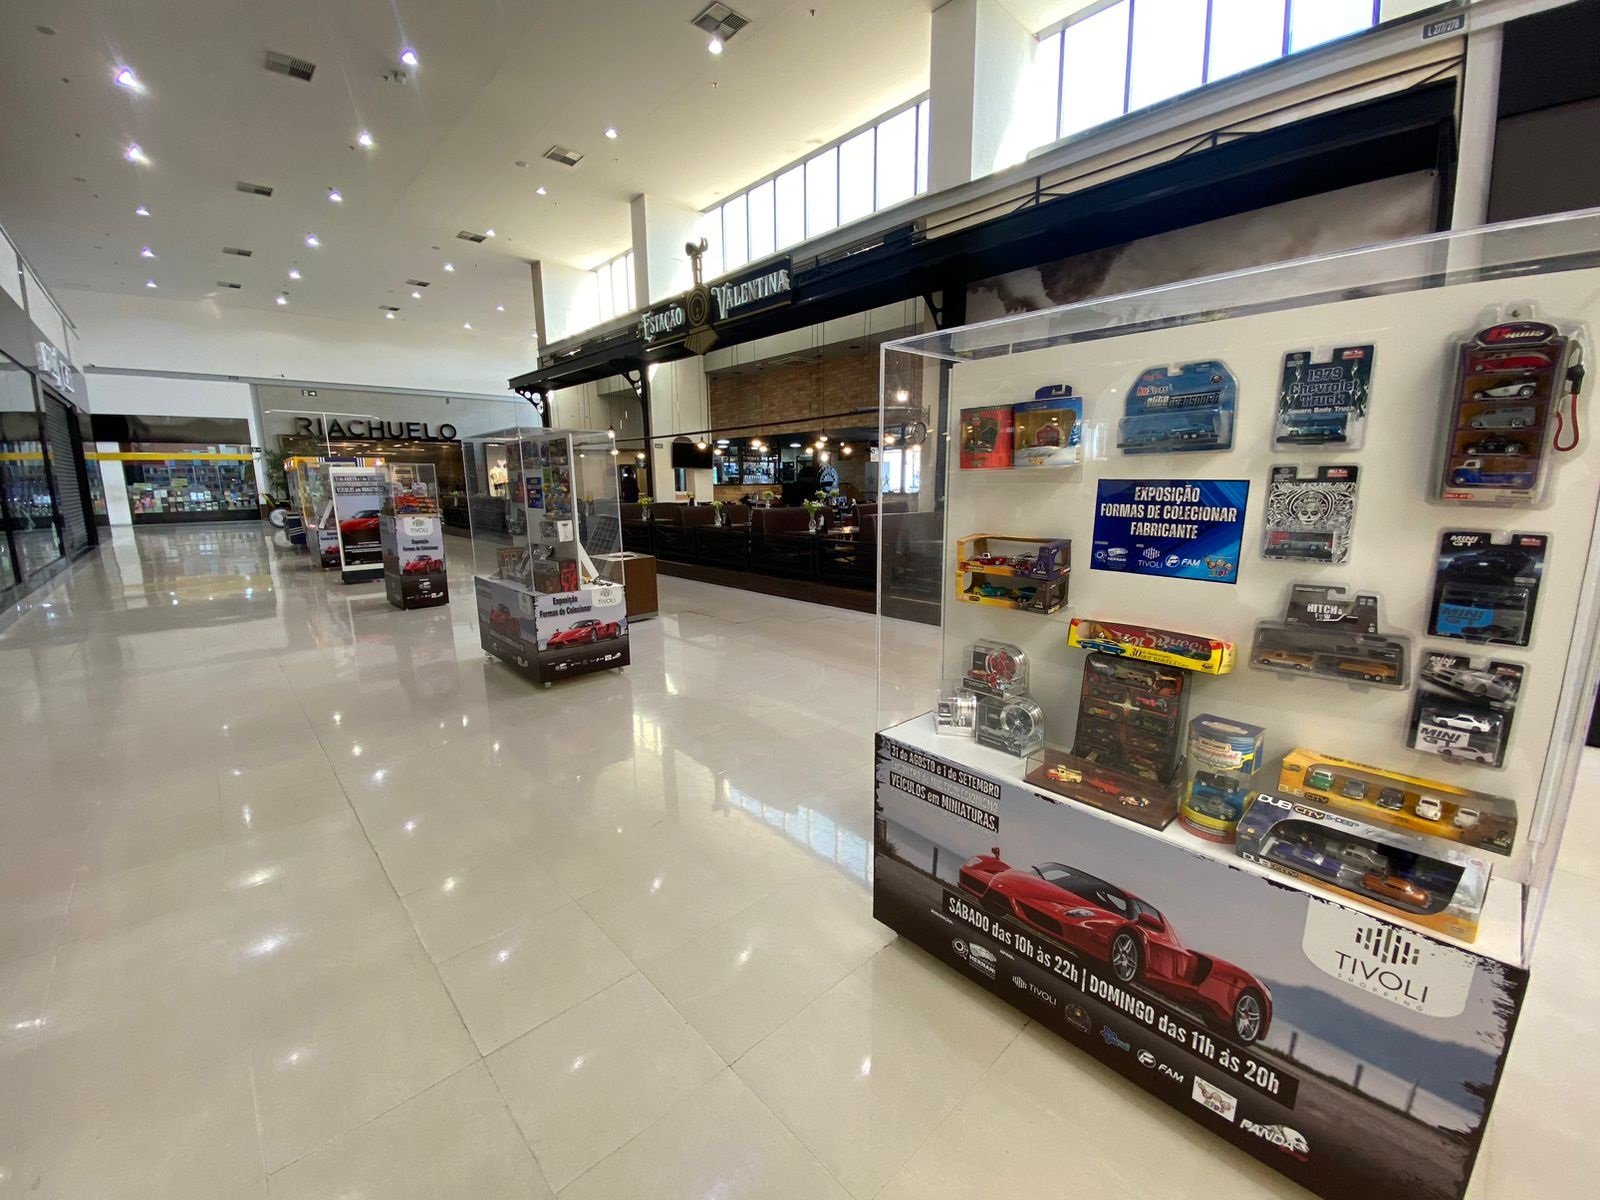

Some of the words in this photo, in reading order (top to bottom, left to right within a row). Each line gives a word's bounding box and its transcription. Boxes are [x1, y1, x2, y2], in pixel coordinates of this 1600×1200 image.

[711, 268, 792, 320] VALENTINA
[1307, 366, 1344, 382] 1979
[1289, 379, 1361, 396] Chevrolet
[1300, 393, 1345, 408] Truck
[294, 416, 457, 441] RIACHUELO
[1134, 484, 1201, 505] EXPOSIÇÃO
[1100, 503, 1145, 518] FORMAS
[1147, 505, 1161, 519] DE
[1163, 505, 1238, 522] COLECIONAR
[1130, 521, 1198, 539] FABRICANTE
[1450, 535, 1479, 543] MINI
[1138, 559, 1163, 569] TIVOLI
[1181, 558, 1201, 567] FAM
[553, 595, 578, 606] Exposição
[1307, 603, 1338, 615] HITCH
[539, 609, 559, 619] Formas
[566, 604, 592, 615] Colecionar
[1440, 608, 1485, 619] MINI
[1420, 727, 1462, 741] MINI
[1422, 735, 1458, 747] GT
[891, 745, 899, 758] 31
[899, 748, 908, 761] de
[909, 751, 936, 773] AGOSTO
[936, 764, 942, 775] e
[943, 765, 947, 777] 1
[947, 766, 957, 781] de
[958, 770, 1000, 799] SETEMBRO
[927, 789, 941, 806] em
[1277, 783, 1304, 798] DUB
[1257, 793, 1293, 811] DUB
[1296, 806, 1325, 819] CITY
[1242, 851, 1271, 868] DUB
[1334, 950, 1429, 1004] TIVOLI
[949, 896, 989, 932] SÁBADO
[992, 921, 1012, 945] das
[1014, 933, 1034, 958] 10h
[1036, 945, 1052, 967] às
[1054, 955, 1079, 983] 22h
[1089, 974, 1154, 1025] DOMINGO
[1158, 1015, 1187, 1044] das
[1191, 1030, 1215, 1060] 11h
[1219, 1048, 1241, 1073] às
[1243, 1060, 1280, 1095] 20h
[1029, 983, 1057, 1006] TIVOLI
[1337, 972, 1424, 1012] SHOPPING
[1158, 1062, 1185, 1083] FAM
